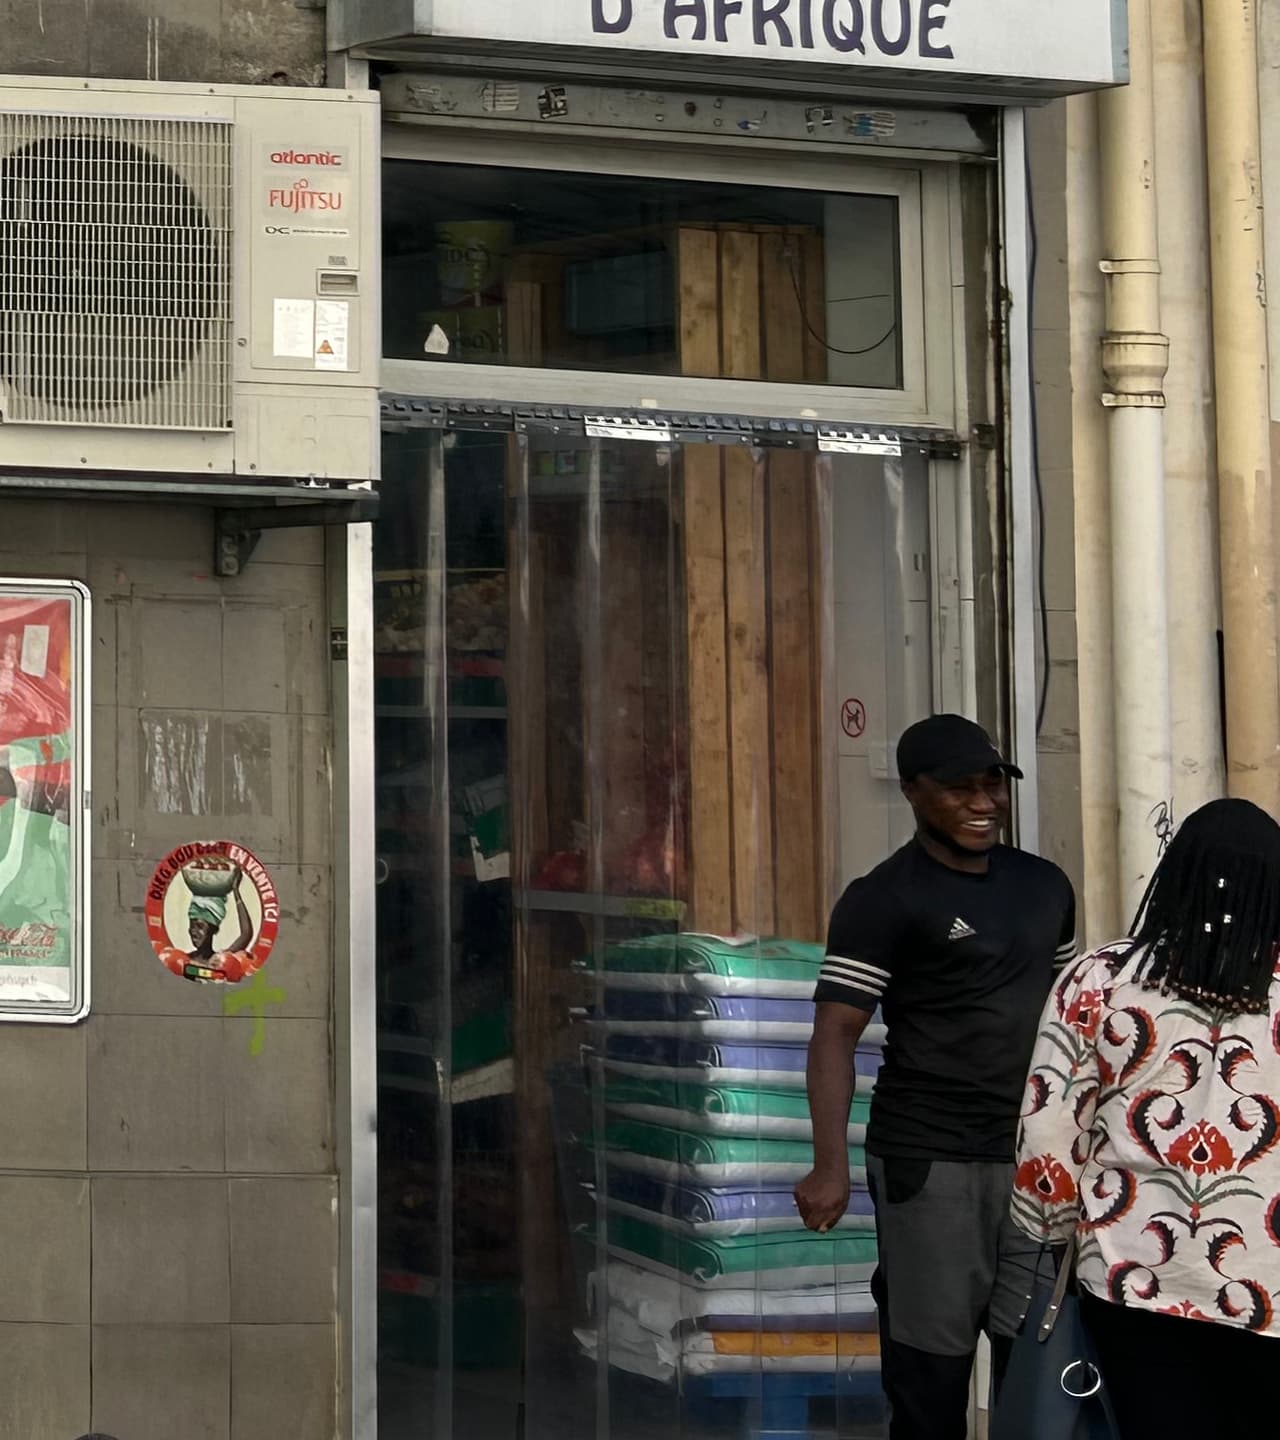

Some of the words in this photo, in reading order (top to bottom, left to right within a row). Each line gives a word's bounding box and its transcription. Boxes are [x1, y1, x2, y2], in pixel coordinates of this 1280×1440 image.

[270, 151, 342, 166] atlantic
[230, 845, 248, 864] EN
[246, 857, 275, 900] VENTE
[263, 903, 278, 923] ICI
